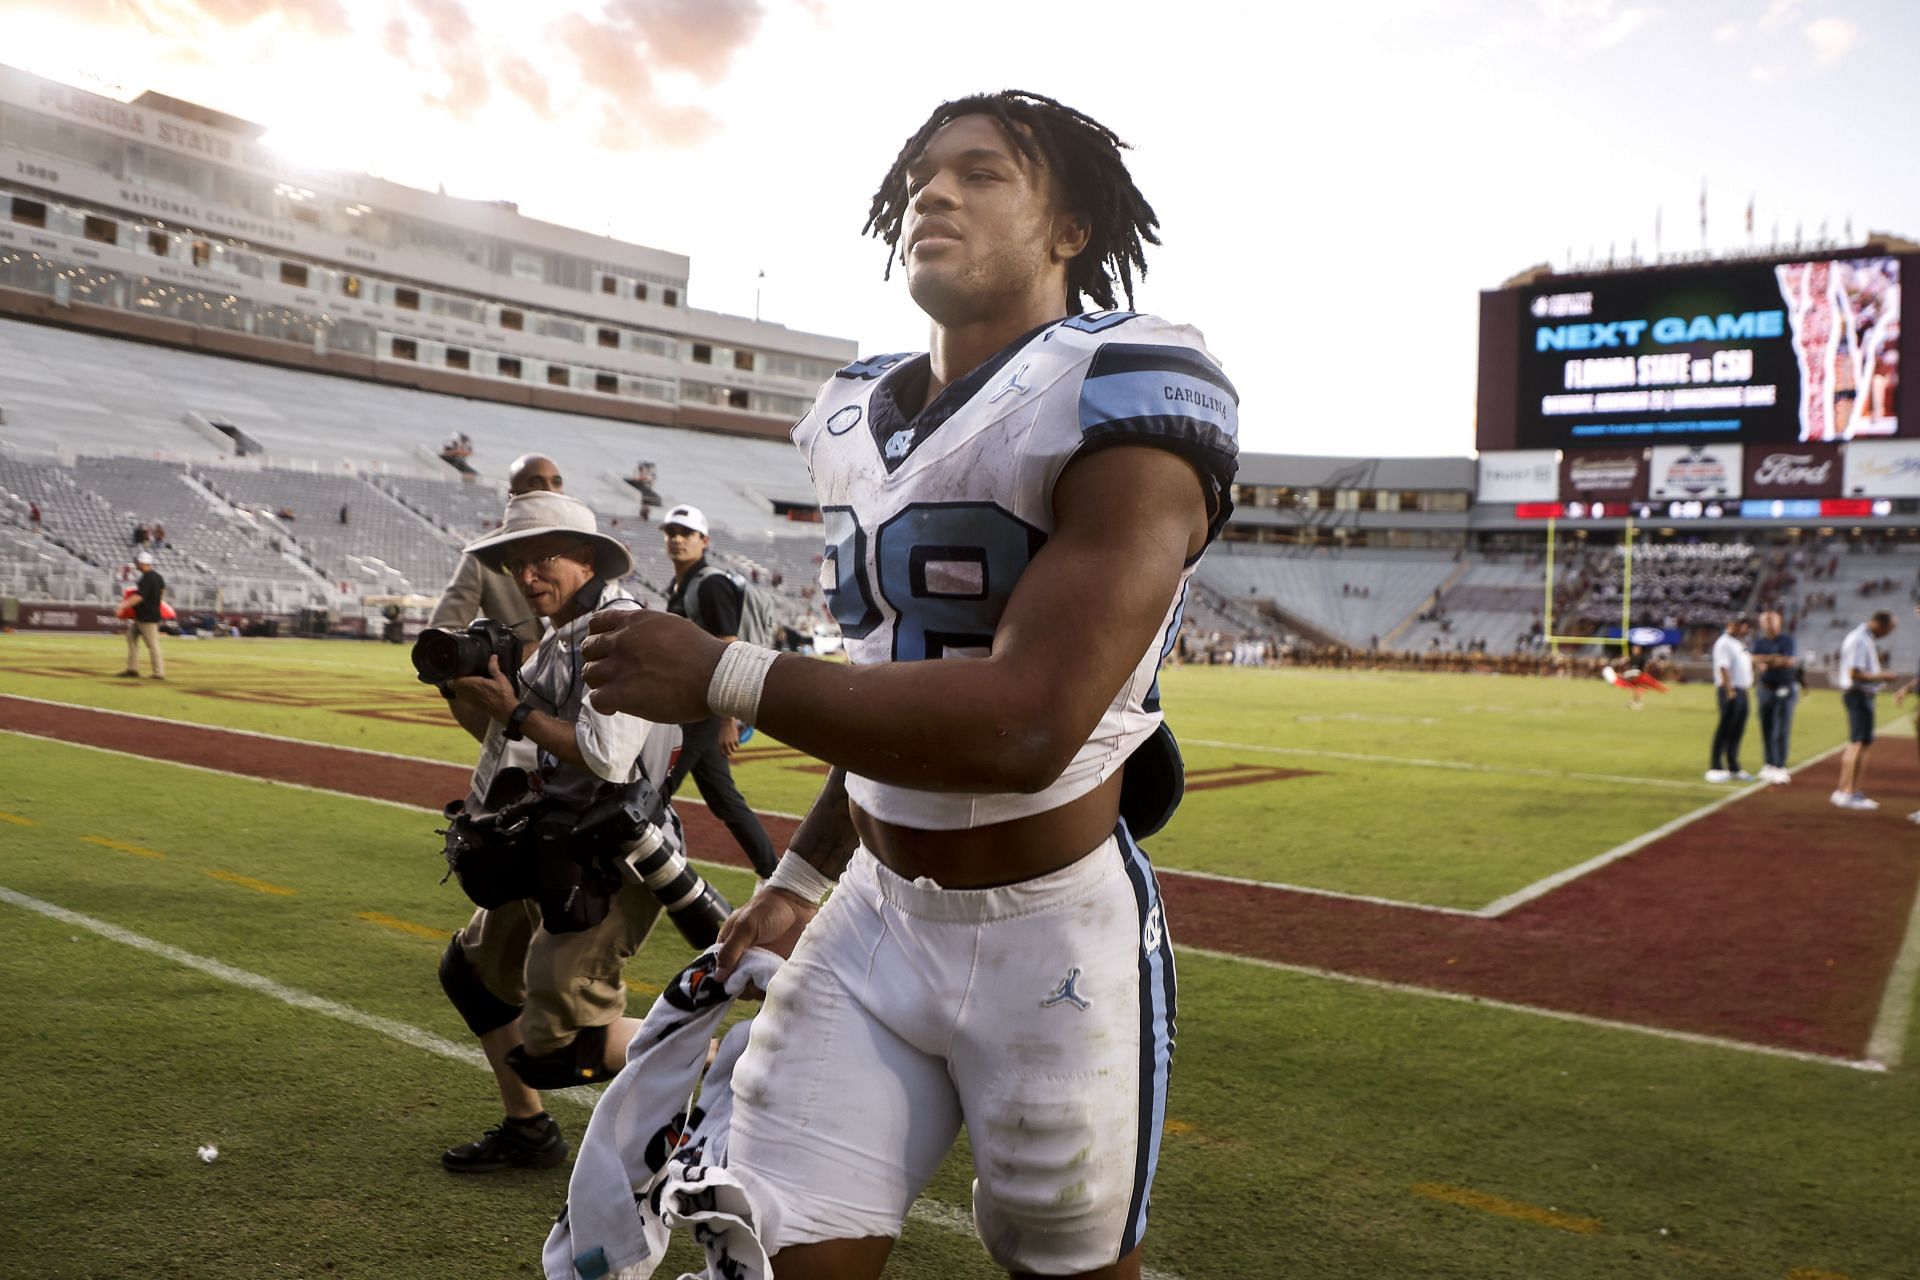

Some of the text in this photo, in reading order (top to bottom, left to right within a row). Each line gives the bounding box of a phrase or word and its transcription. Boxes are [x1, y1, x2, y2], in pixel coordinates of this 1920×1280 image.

[157, 119, 233, 160] STATE
[119, 189, 296, 243] NATIONAL CHAMPIONS
[1536, 310, 1784, 352] NEXT GAME
[1163, 385, 1227, 420] CAROLINA
[1754, 453, 1832, 485] Ford
